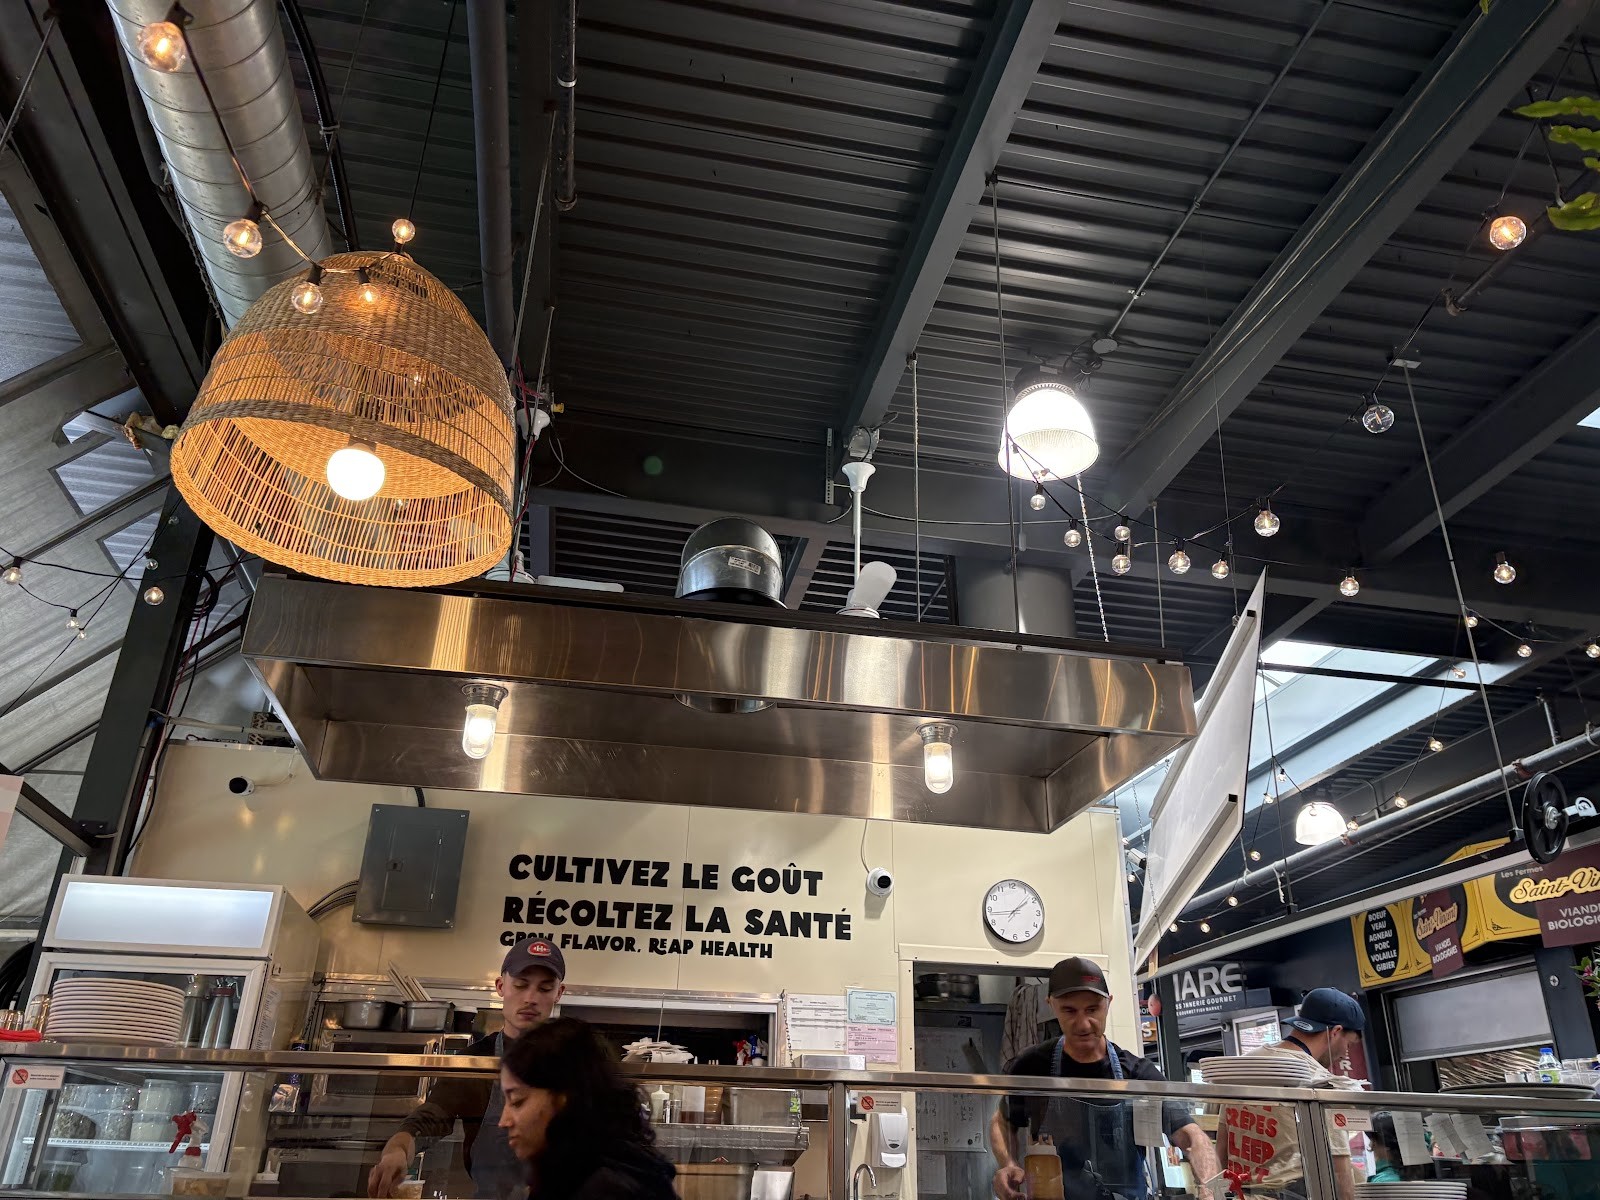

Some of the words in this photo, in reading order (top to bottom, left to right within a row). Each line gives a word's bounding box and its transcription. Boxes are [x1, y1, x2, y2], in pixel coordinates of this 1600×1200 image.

[509, 854, 670, 887] CULTIVEZ
[682, 863, 719, 890] LE
[732, 862, 823, 896] GOÛT
[1515, 866, 1543, 876] Fermes
[503, 891, 673, 930] RÉCOLTEZ
[686, 905, 731, 933] LA
[744, 908, 851, 940] SANTÉ
[1368, 910, 1387, 922] BOEUF
[1371, 921, 1387, 931] VEAU
[1369, 929, 1393, 942] AGNEAU
[561, 933, 641, 953] FLAVOR,
[649, 937, 693, 955] REAP
[700, 940, 773, 958] HEALTH
[1374, 941, 1390, 951] PORC
[1370, 949, 1397, 962] VOLAILLE
[1376, 961, 1395, 972] GIBIER
[1206, 995, 1236, 1005] GOURMET
